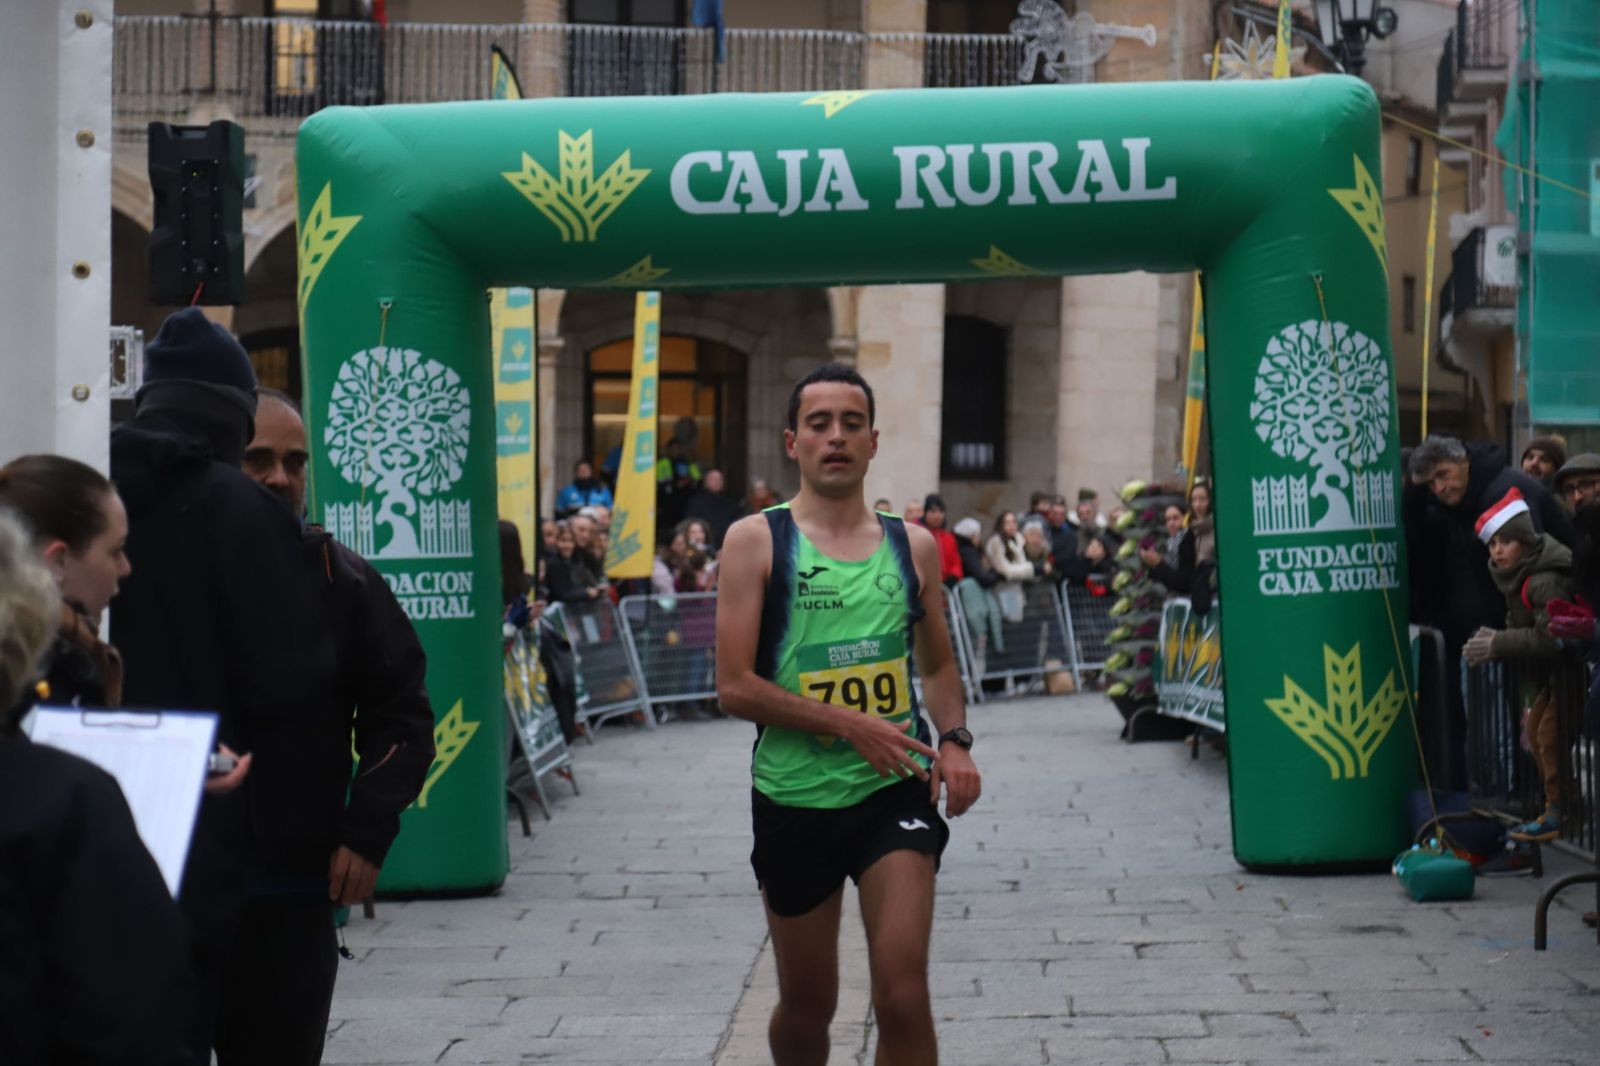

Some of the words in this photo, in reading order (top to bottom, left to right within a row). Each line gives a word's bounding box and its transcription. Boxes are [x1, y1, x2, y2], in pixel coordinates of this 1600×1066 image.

[669, 148, 869, 217] CAJA
[893, 137, 1177, 208] RURAL
[1258, 542, 1398, 571] FUNDACION
[1259, 571, 1323, 596] CAJA
[1329, 566, 1400, 592] RURAL
[803, 600, 844, 610] UCLM
[829, 651, 850, 662] CAJA
[852, 648, 881, 660] RURAL
[809, 672, 897, 715] 799
